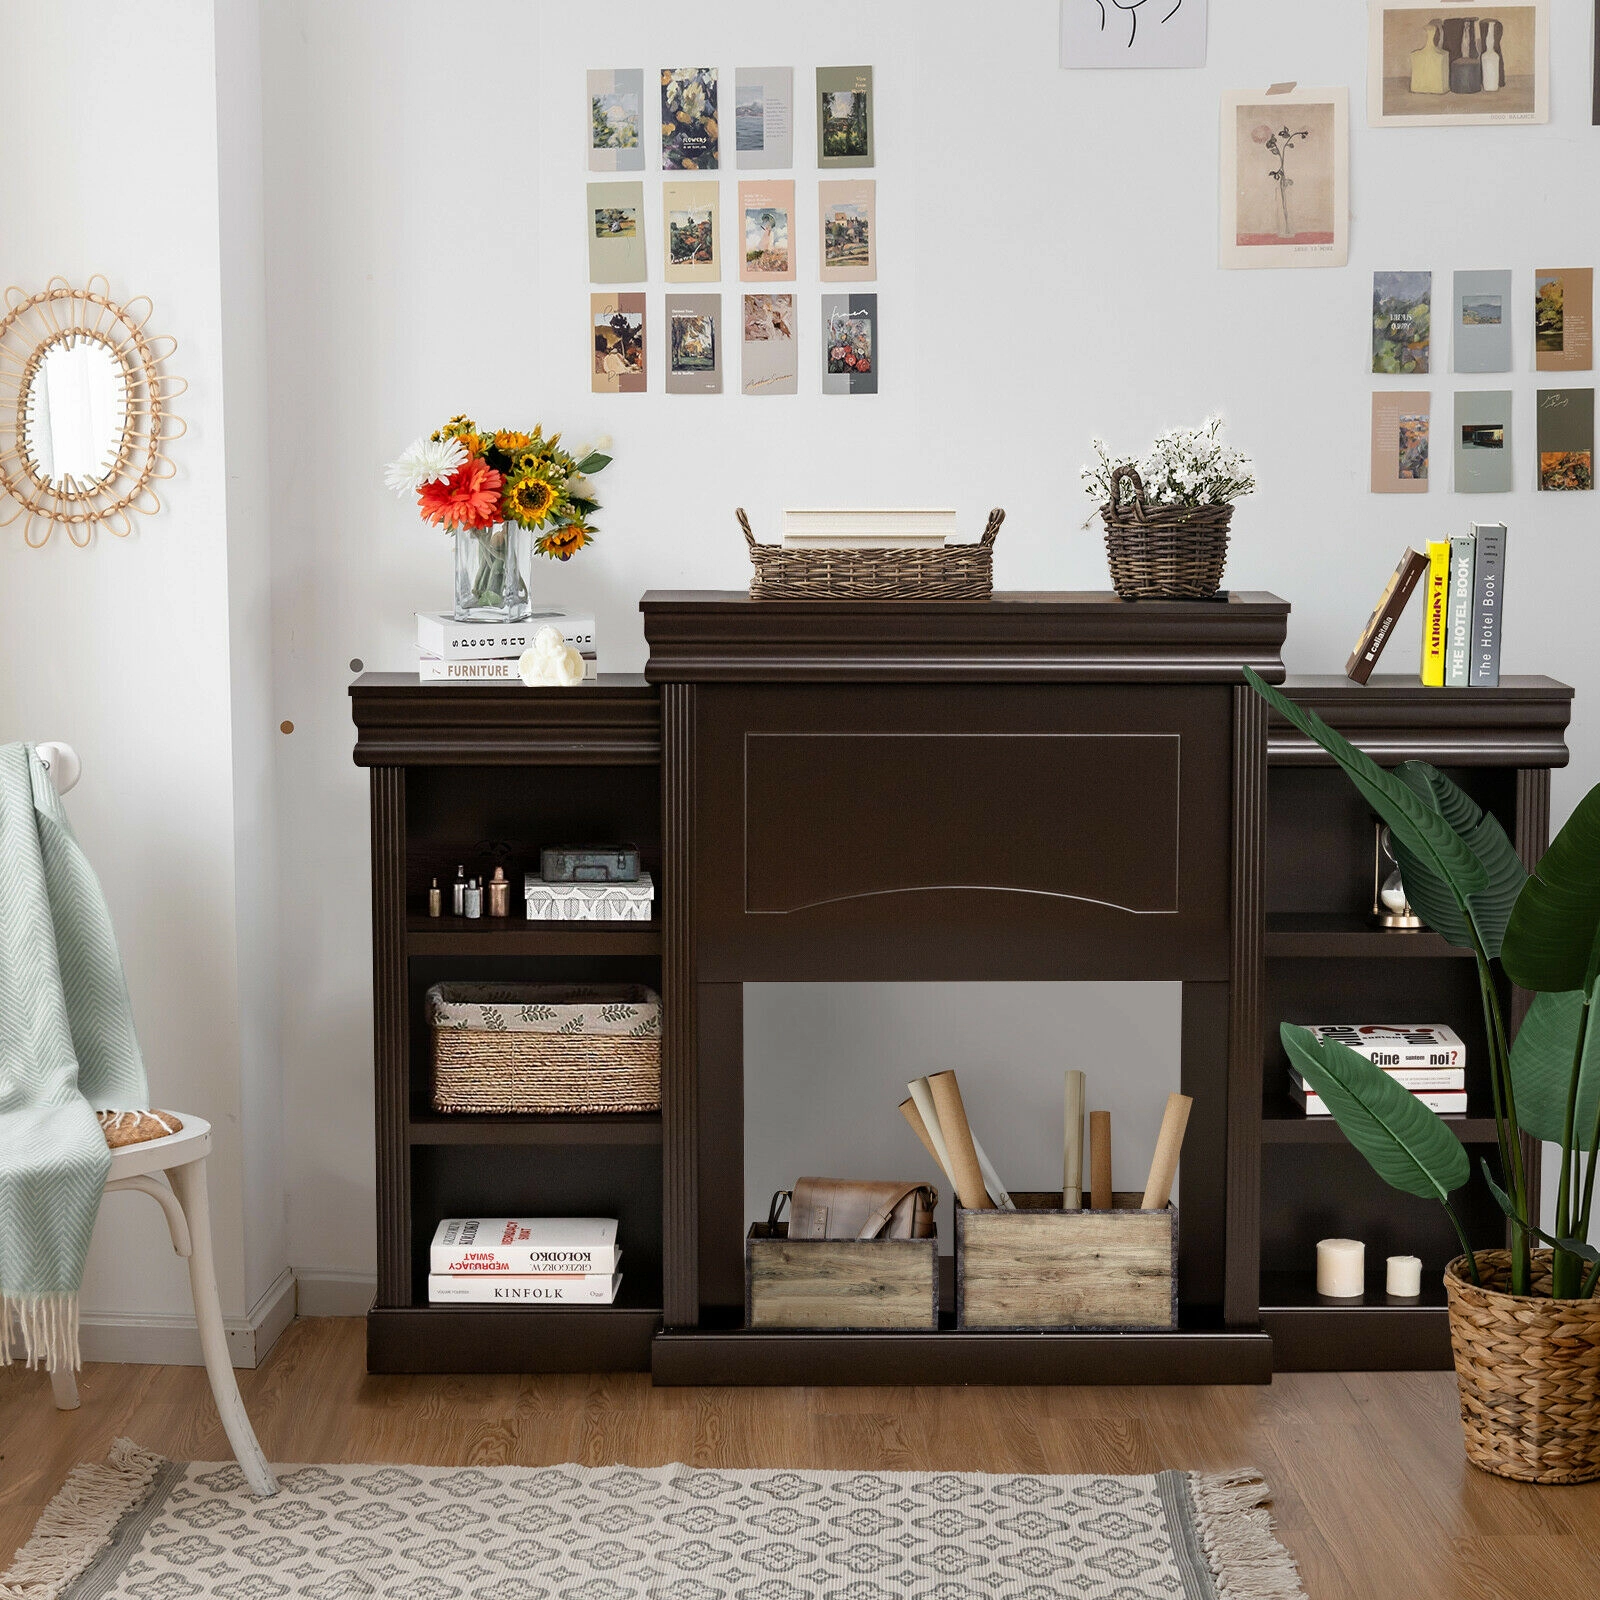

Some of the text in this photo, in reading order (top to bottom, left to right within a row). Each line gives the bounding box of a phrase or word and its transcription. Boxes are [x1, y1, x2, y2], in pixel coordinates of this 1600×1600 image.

[1457, 557, 1470, 597] BOOK
[1454, 601, 1466, 647] HOTEL
[1479, 574, 1495, 677] The Hotel Book
[452, 638, 495, 647] speed
[501, 637, 526, 646] and
[1453, 650, 1464, 678] THE
[448, 665, 509, 677] FURNITURE
[1371, 1052, 1400, 1065] Cine
[464, 1253, 495, 1262] ŚWIAT
[530, 1252, 592, 1262] KOŁODKO
[449, 1261, 510, 1271] WĘDRUJĄCY
[543, 1263, 592, 1272] GRZEGORZ
[494, 1288, 563, 1298] KINFOLK
